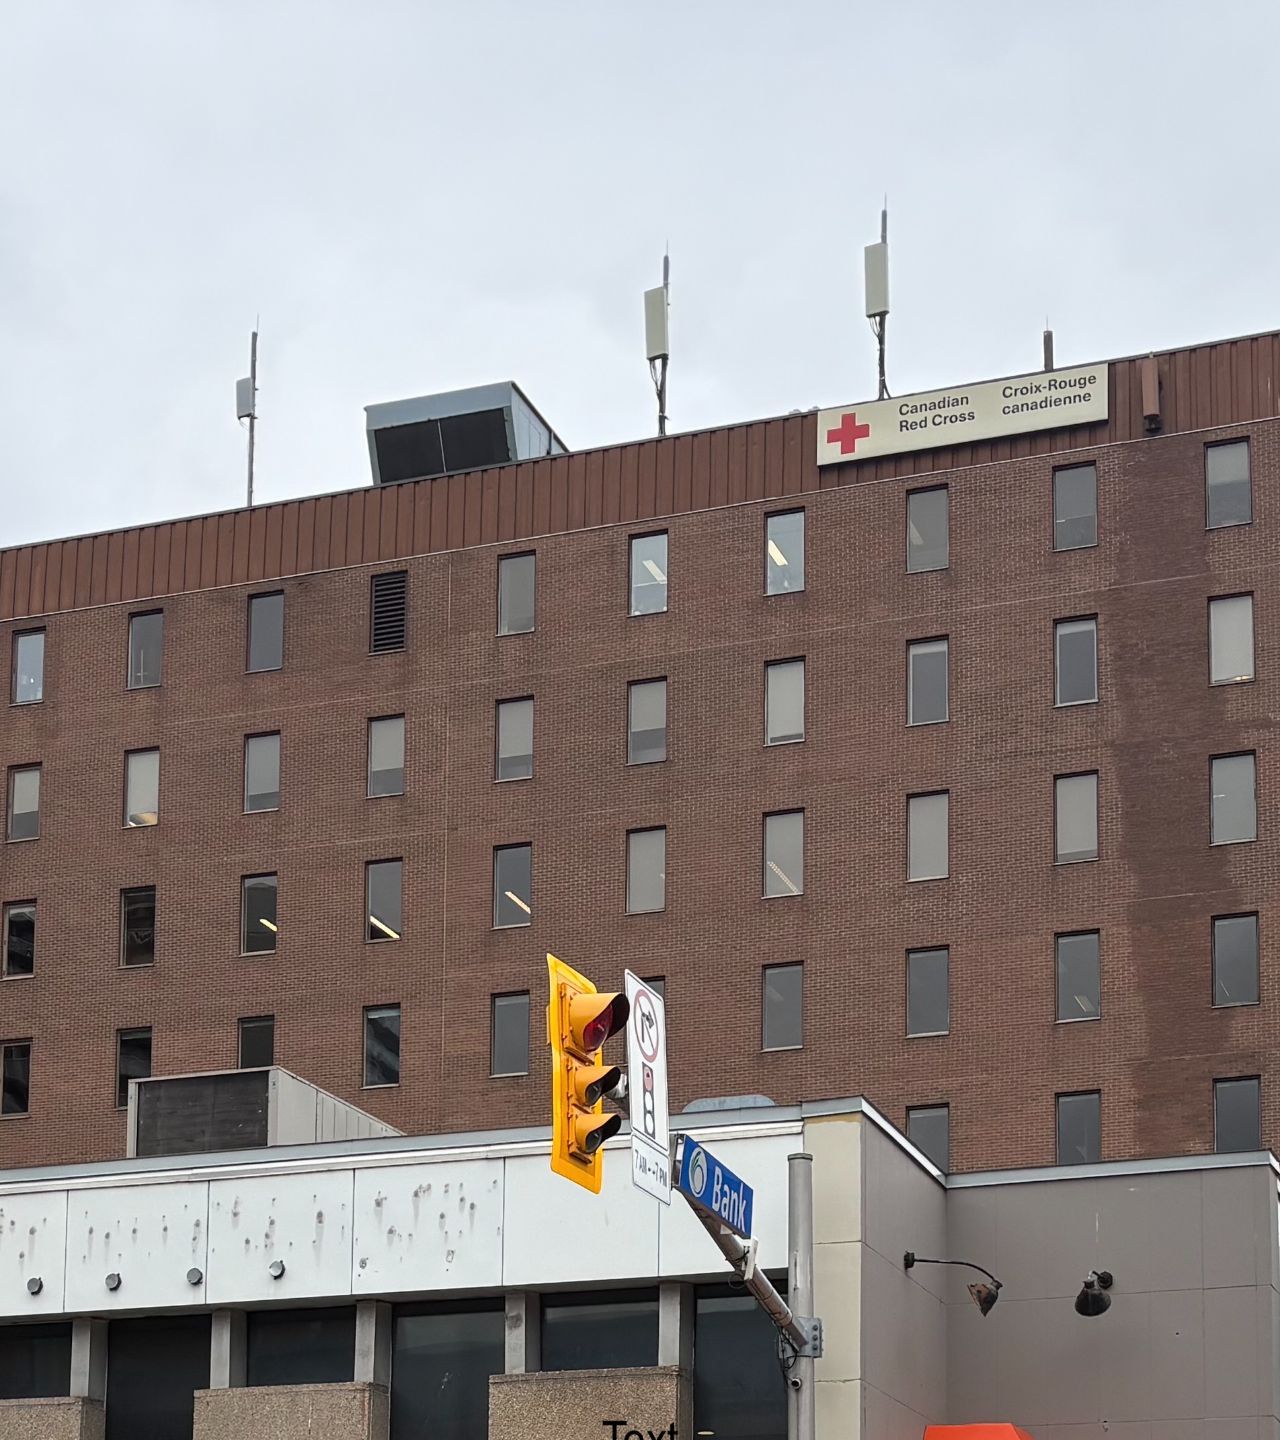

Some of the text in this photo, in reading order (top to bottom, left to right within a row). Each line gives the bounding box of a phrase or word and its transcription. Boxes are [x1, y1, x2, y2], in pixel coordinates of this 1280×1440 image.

[1001, 374, 1098, 399] Croix-Rouge
[899, 394, 970, 417] Canadian
[1001, 391, 1092, 415] canadienne
[899, 409, 976, 433] Red Cross
[711, 1165, 747, 1233] Bank
